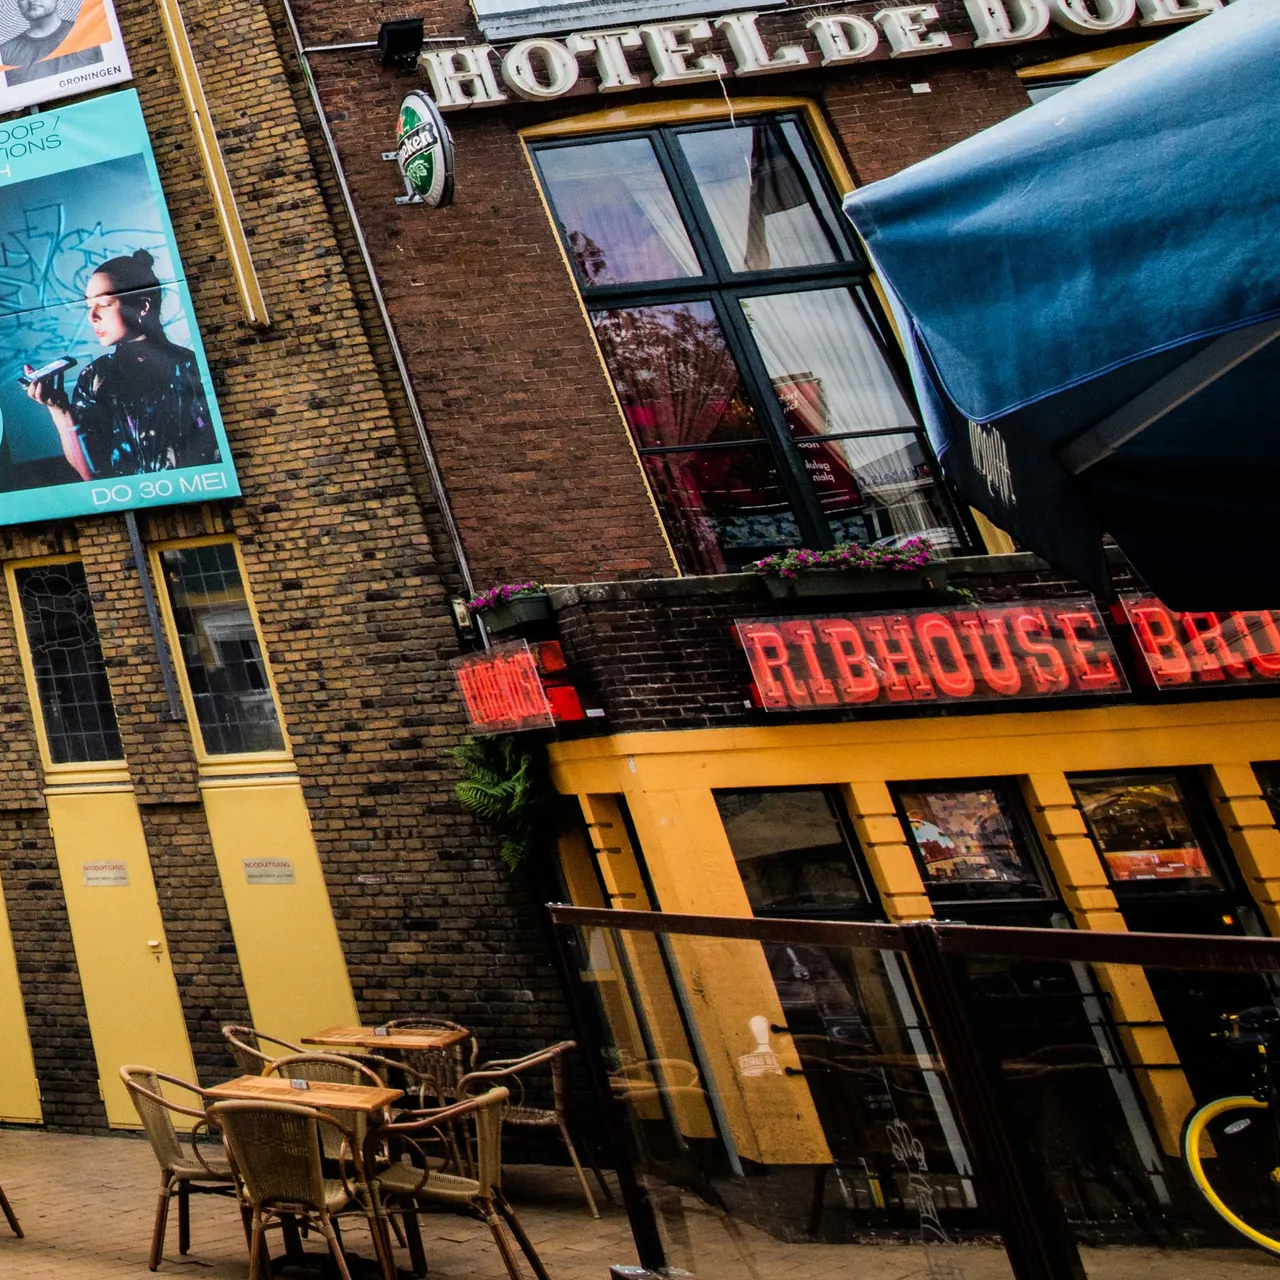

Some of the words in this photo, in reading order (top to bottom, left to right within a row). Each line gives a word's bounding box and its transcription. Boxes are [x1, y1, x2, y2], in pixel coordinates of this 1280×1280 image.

[420, 10, 810, 111] HOTEL
[806, 3, 952, 66] DE
[58, 65, 122, 88] GRONINGEN
[92, 484, 132, 505] DO
[139, 479, 173, 499] 30
[179, 471, 228, 494] MEI
[746, 609, 1121, 709] RIBHOUSE
[244, 861, 291, 869] NOODUITGANG
